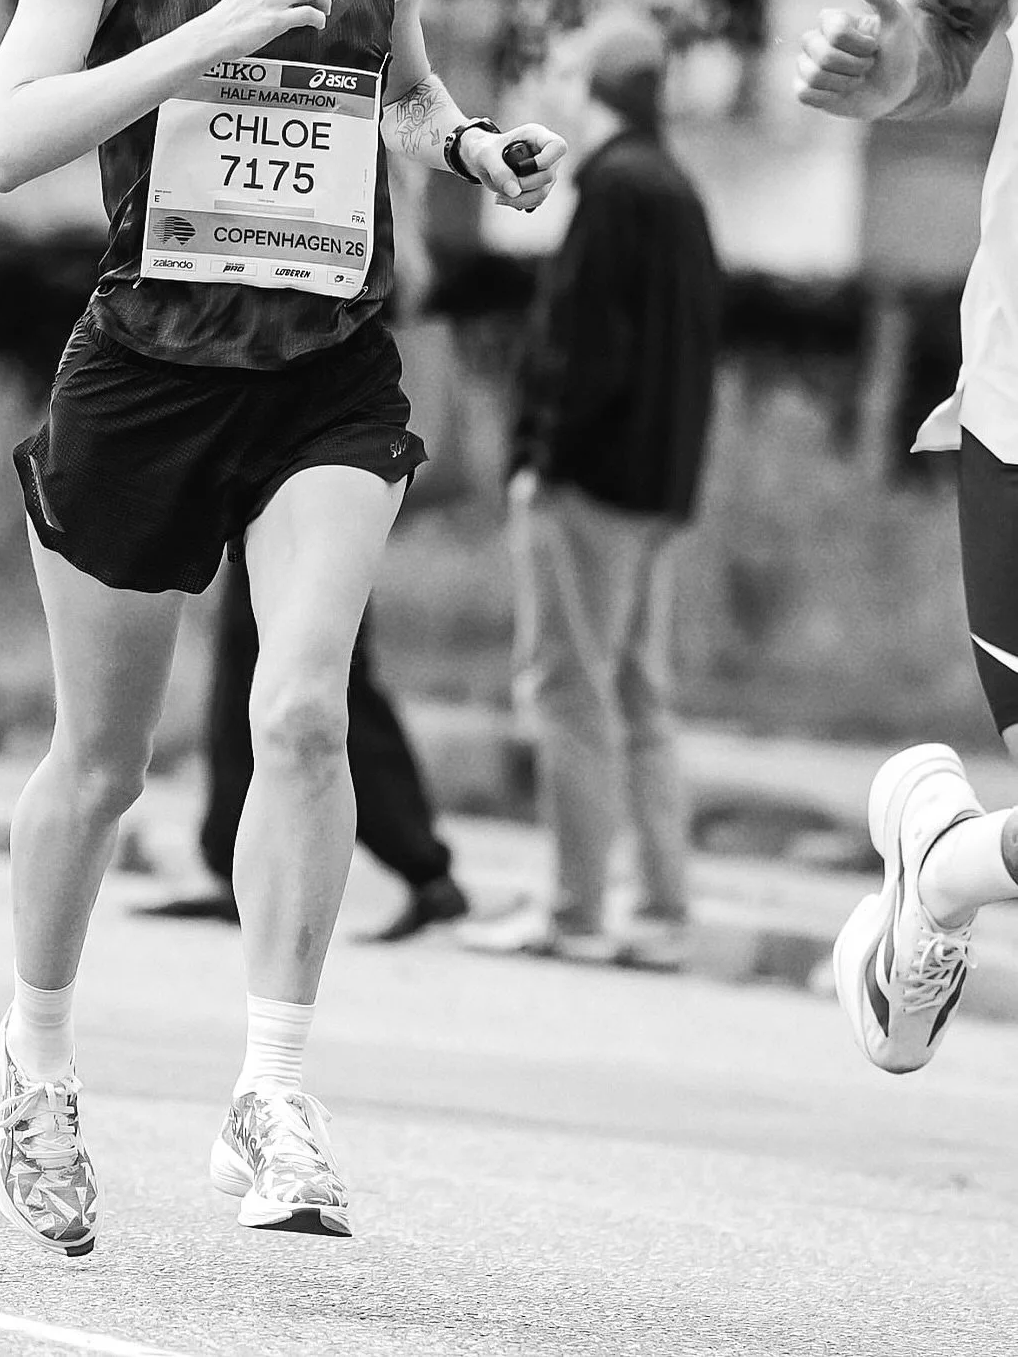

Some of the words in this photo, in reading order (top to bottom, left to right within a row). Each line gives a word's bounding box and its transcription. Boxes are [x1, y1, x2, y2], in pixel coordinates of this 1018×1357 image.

[202, 61, 267, 82] EIKO
[325, 73, 358, 90] asics
[220, 87, 257, 101] HALF
[258, 90, 336, 108] MARATHON
[209, 112, 332, 150] CHLOE
[220, 154, 315, 194] 7175
[154, 194, 161, 203] E
[351, 214, 366, 225] FRA
[213, 226, 342, 254] COPENHAGEN
[345, 241, 365, 257] 26
[152, 258, 194, 270] zalando
